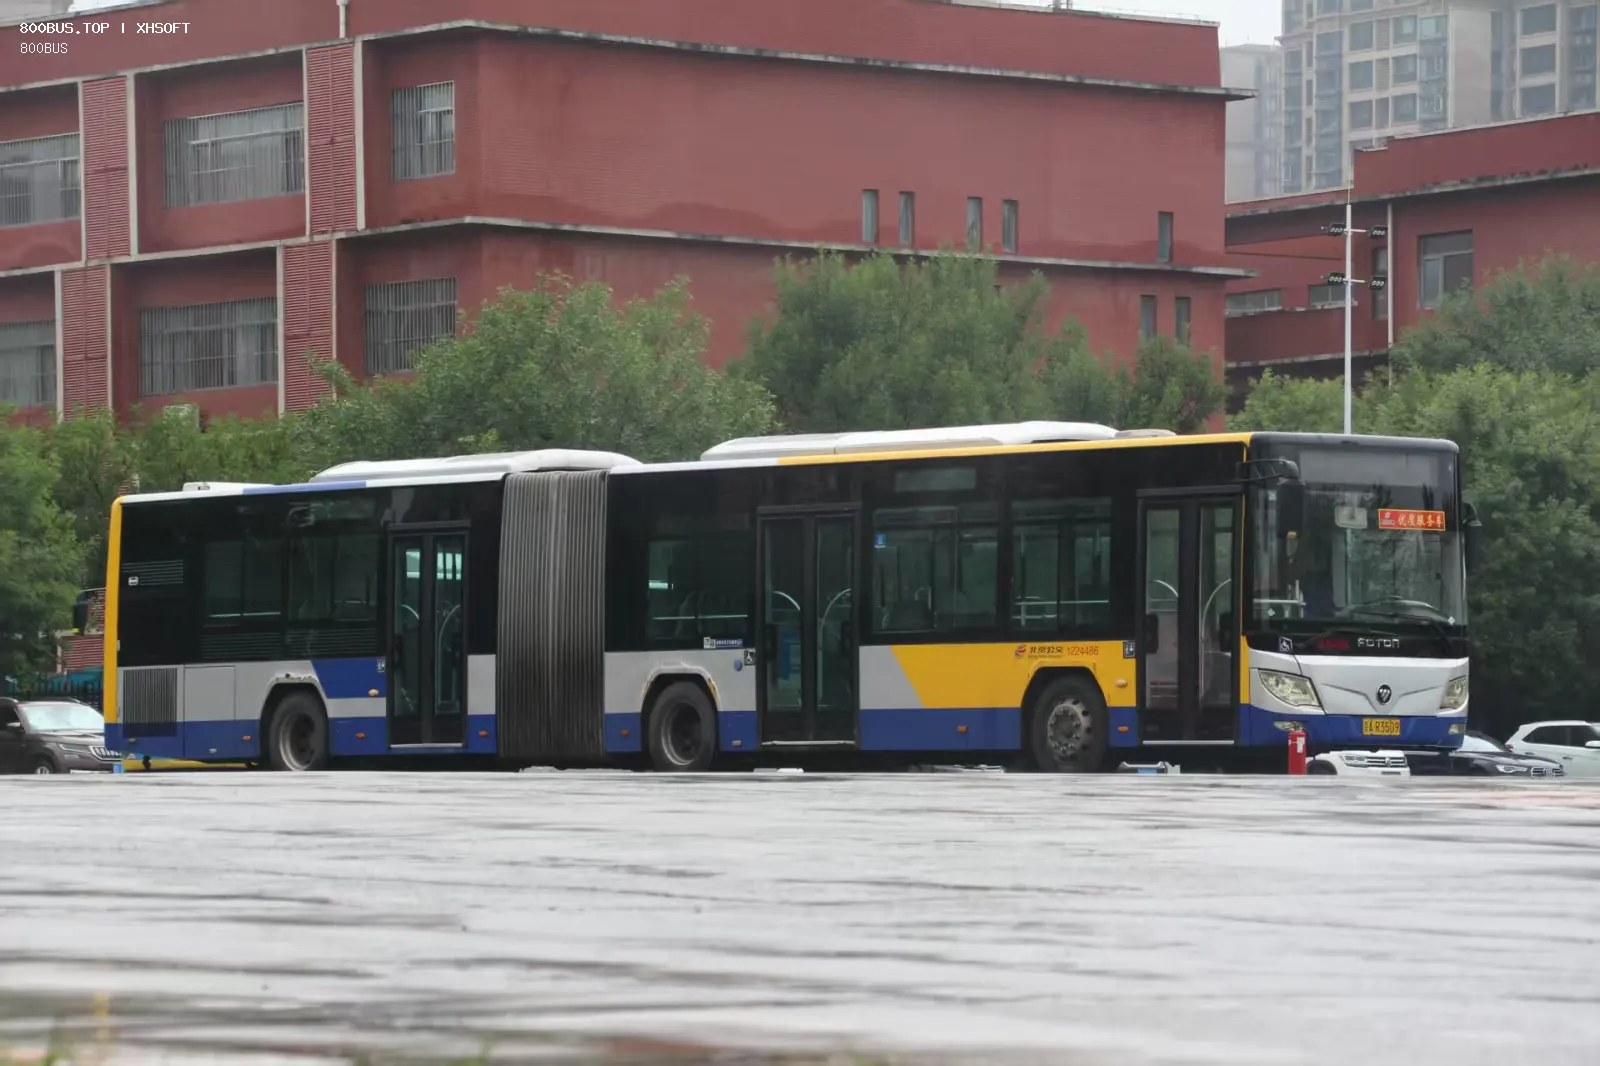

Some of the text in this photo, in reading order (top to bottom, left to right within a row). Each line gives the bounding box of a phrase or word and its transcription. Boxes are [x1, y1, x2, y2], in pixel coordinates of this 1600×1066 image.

[1357, 637, 1400, 648] FOTON
[1029, 645, 1065, 654] 北京公交
